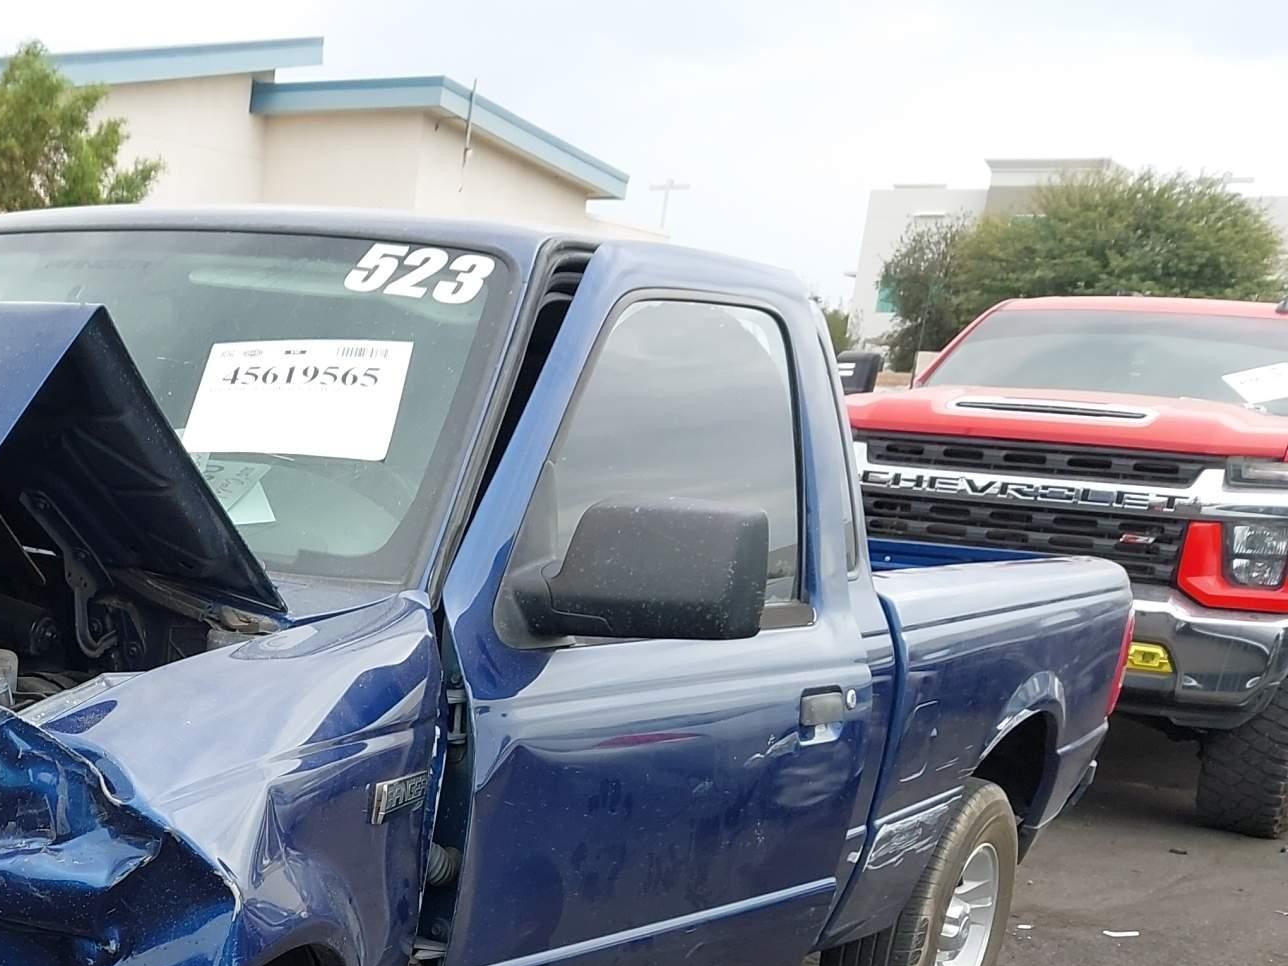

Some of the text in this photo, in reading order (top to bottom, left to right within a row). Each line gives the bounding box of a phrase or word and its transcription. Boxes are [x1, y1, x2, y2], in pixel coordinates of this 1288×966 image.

[344, 243, 495, 304] 523
[222, 366, 381, 387] 45619565
[859, 470, 1189, 512] CHEVROLET
